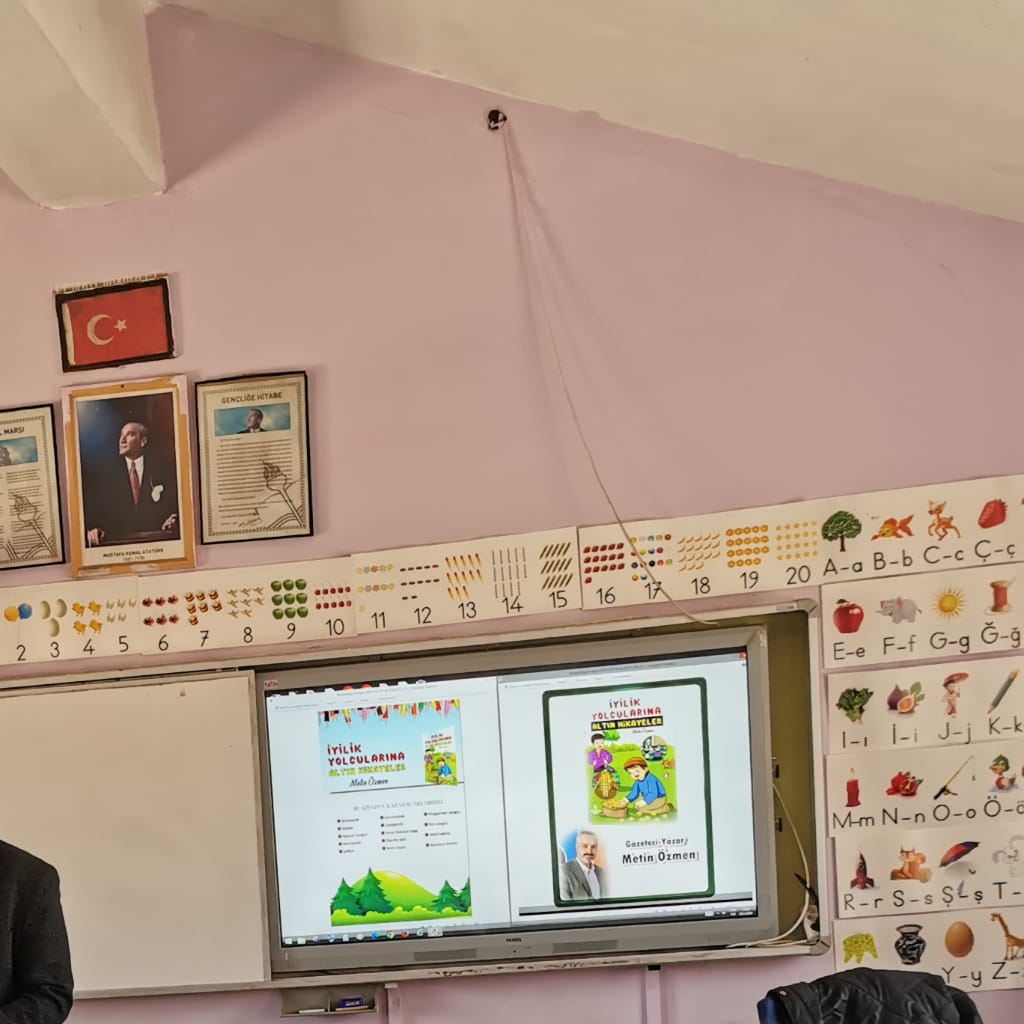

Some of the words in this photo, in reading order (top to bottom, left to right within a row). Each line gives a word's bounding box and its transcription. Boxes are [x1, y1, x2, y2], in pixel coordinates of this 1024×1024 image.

[221, 393, 255, 404] GENÇLİĞE
[257, 391, 282, 400] HİTABE
[4, 426, 24, 434] MARŞI
[823, 558, 863, 576] A-a
[873, 549, 913, 570] B-b
[923, 545, 965, 564] C-c
[17, 644, 27, 661] 2
[50, 641, 60, 658] 3
[82, 639, 95, 655] 4
[118, 635, 129, 652] 5
[158, 634, 169, 651] 6
[199, 630, 209, 647] 7
[243, 627, 253, 643] 8
[286, 622, 296, 640] 9
[326, 618, 345, 636] 10
[371, 611, 387, 629] 11
[414, 606, 432, 625] 12
[457, 601, 477, 619] 13
[501, 596, 524, 614] 14
[549, 590, 568, 608] 15
[596, 586, 616, 605] 16
[644, 581, 662, 599] 17
[691, 576, 711, 594] 18
[740, 571, 759, 589] 19
[786, 565, 811, 585] 20
[833, 641, 866, 660] E-e
[883, 635, 916, 655] F-f
[929, 631, 970, 654] G-g
[609, 697, 640, 708] İYİLİK
[592, 706, 661, 720] YOLCULARINA
[327, 742, 362, 755] İYİLİK
[328, 752, 405, 766] YOLCULARINA
[622, 853, 654, 864] Metin
[658, 848, 696, 861] Özmen
[992, 961, 1024, 980] Z-
